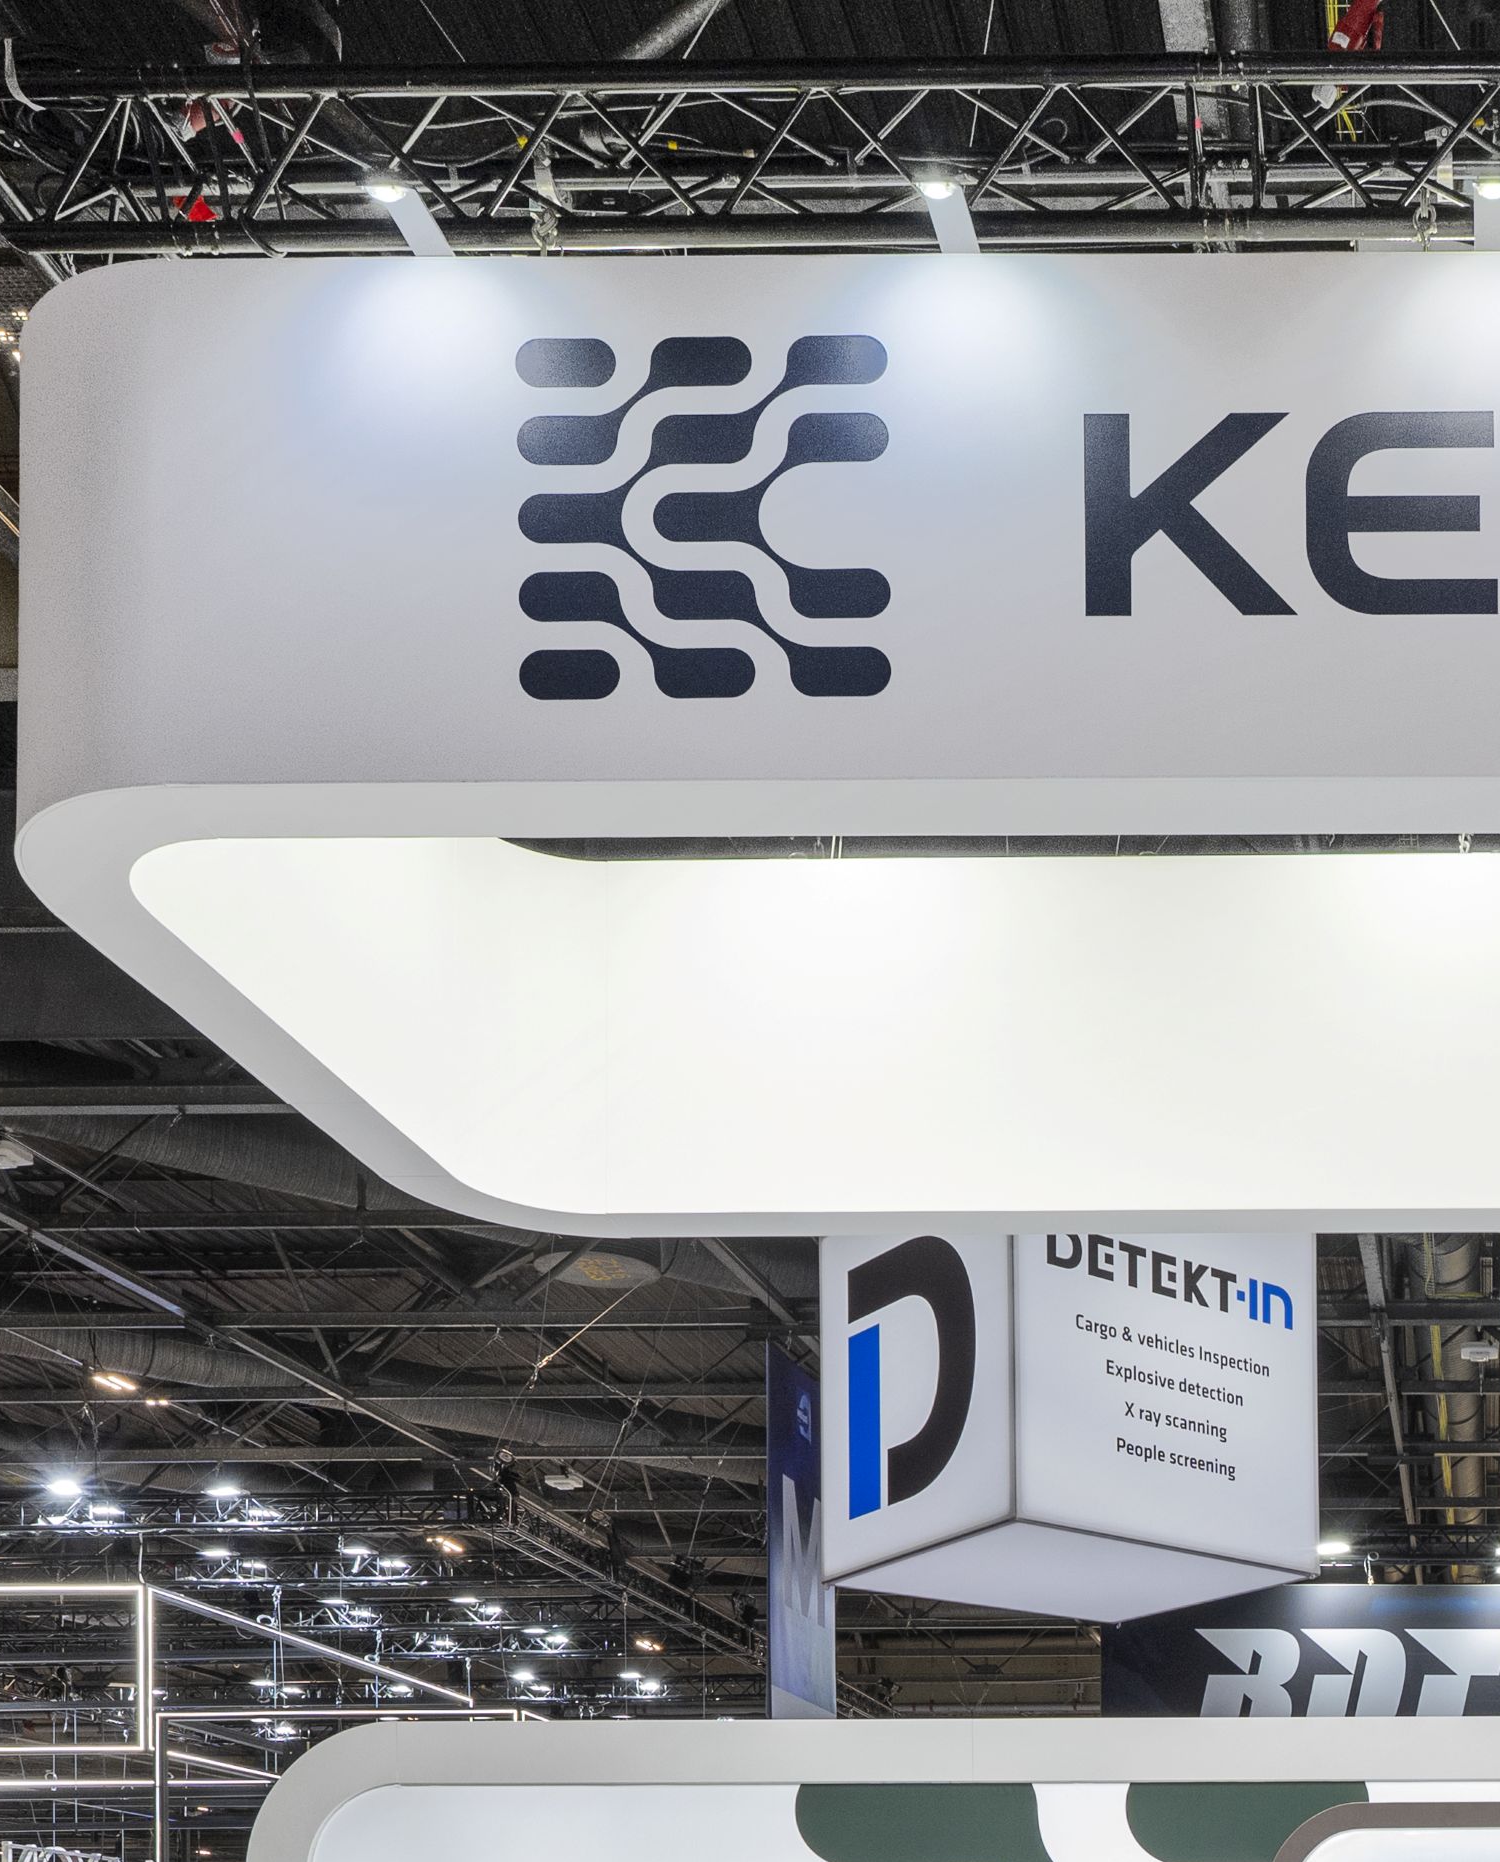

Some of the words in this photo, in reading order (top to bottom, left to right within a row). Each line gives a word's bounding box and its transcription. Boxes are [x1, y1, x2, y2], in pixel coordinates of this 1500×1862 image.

[1076, 1314, 1117, 1340] Cargo
[1122, 1326, 1133, 1343] &
[1138, 1333, 1195, 1358] vehicles
[1199, 1346, 1270, 1377] Inspection
[1106, 1359, 1175, 1390] Explosive
[1179, 1378, 1243, 1407] detection
[1124, 1401, 1135, 1418] X
[1139, 1408, 1161, 1427] ray
[1165, 1414, 1227, 1443] scanning
[1116, 1437, 1165, 1462] People
[1170, 1451, 1236, 1481] screening
